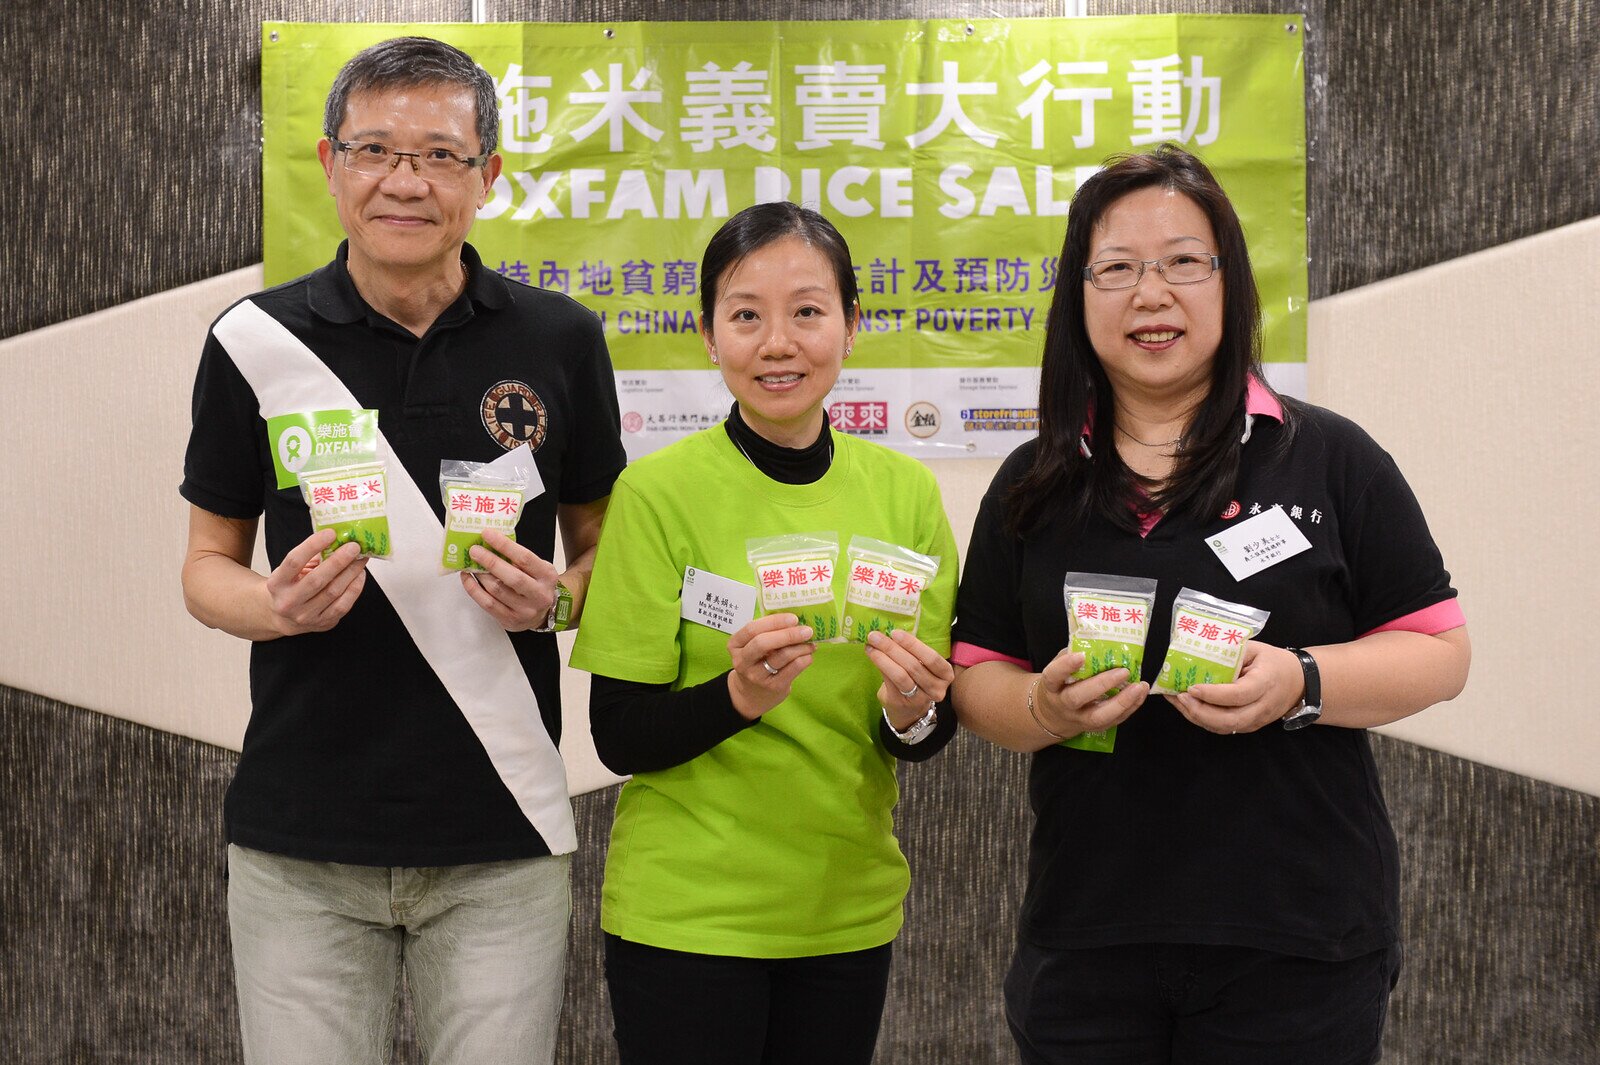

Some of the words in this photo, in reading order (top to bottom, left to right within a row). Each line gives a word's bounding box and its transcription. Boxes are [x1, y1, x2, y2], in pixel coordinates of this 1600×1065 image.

[476, 168, 729, 220] OXFAM
[755, 166, 914, 218] RICE
[618, 310, 698, 334] CHINA
[916, 307, 1035, 332] POVERTY
[484, 401, 502, 435] LIFE
[451, 494, 518, 515] 樂施米
[763, 565, 831, 588] 樂施米
[852, 565, 920, 595] 樂施米
[1077, 602, 1144, 624] 樂施米
[1177, 615, 1243, 645] 樂施米
